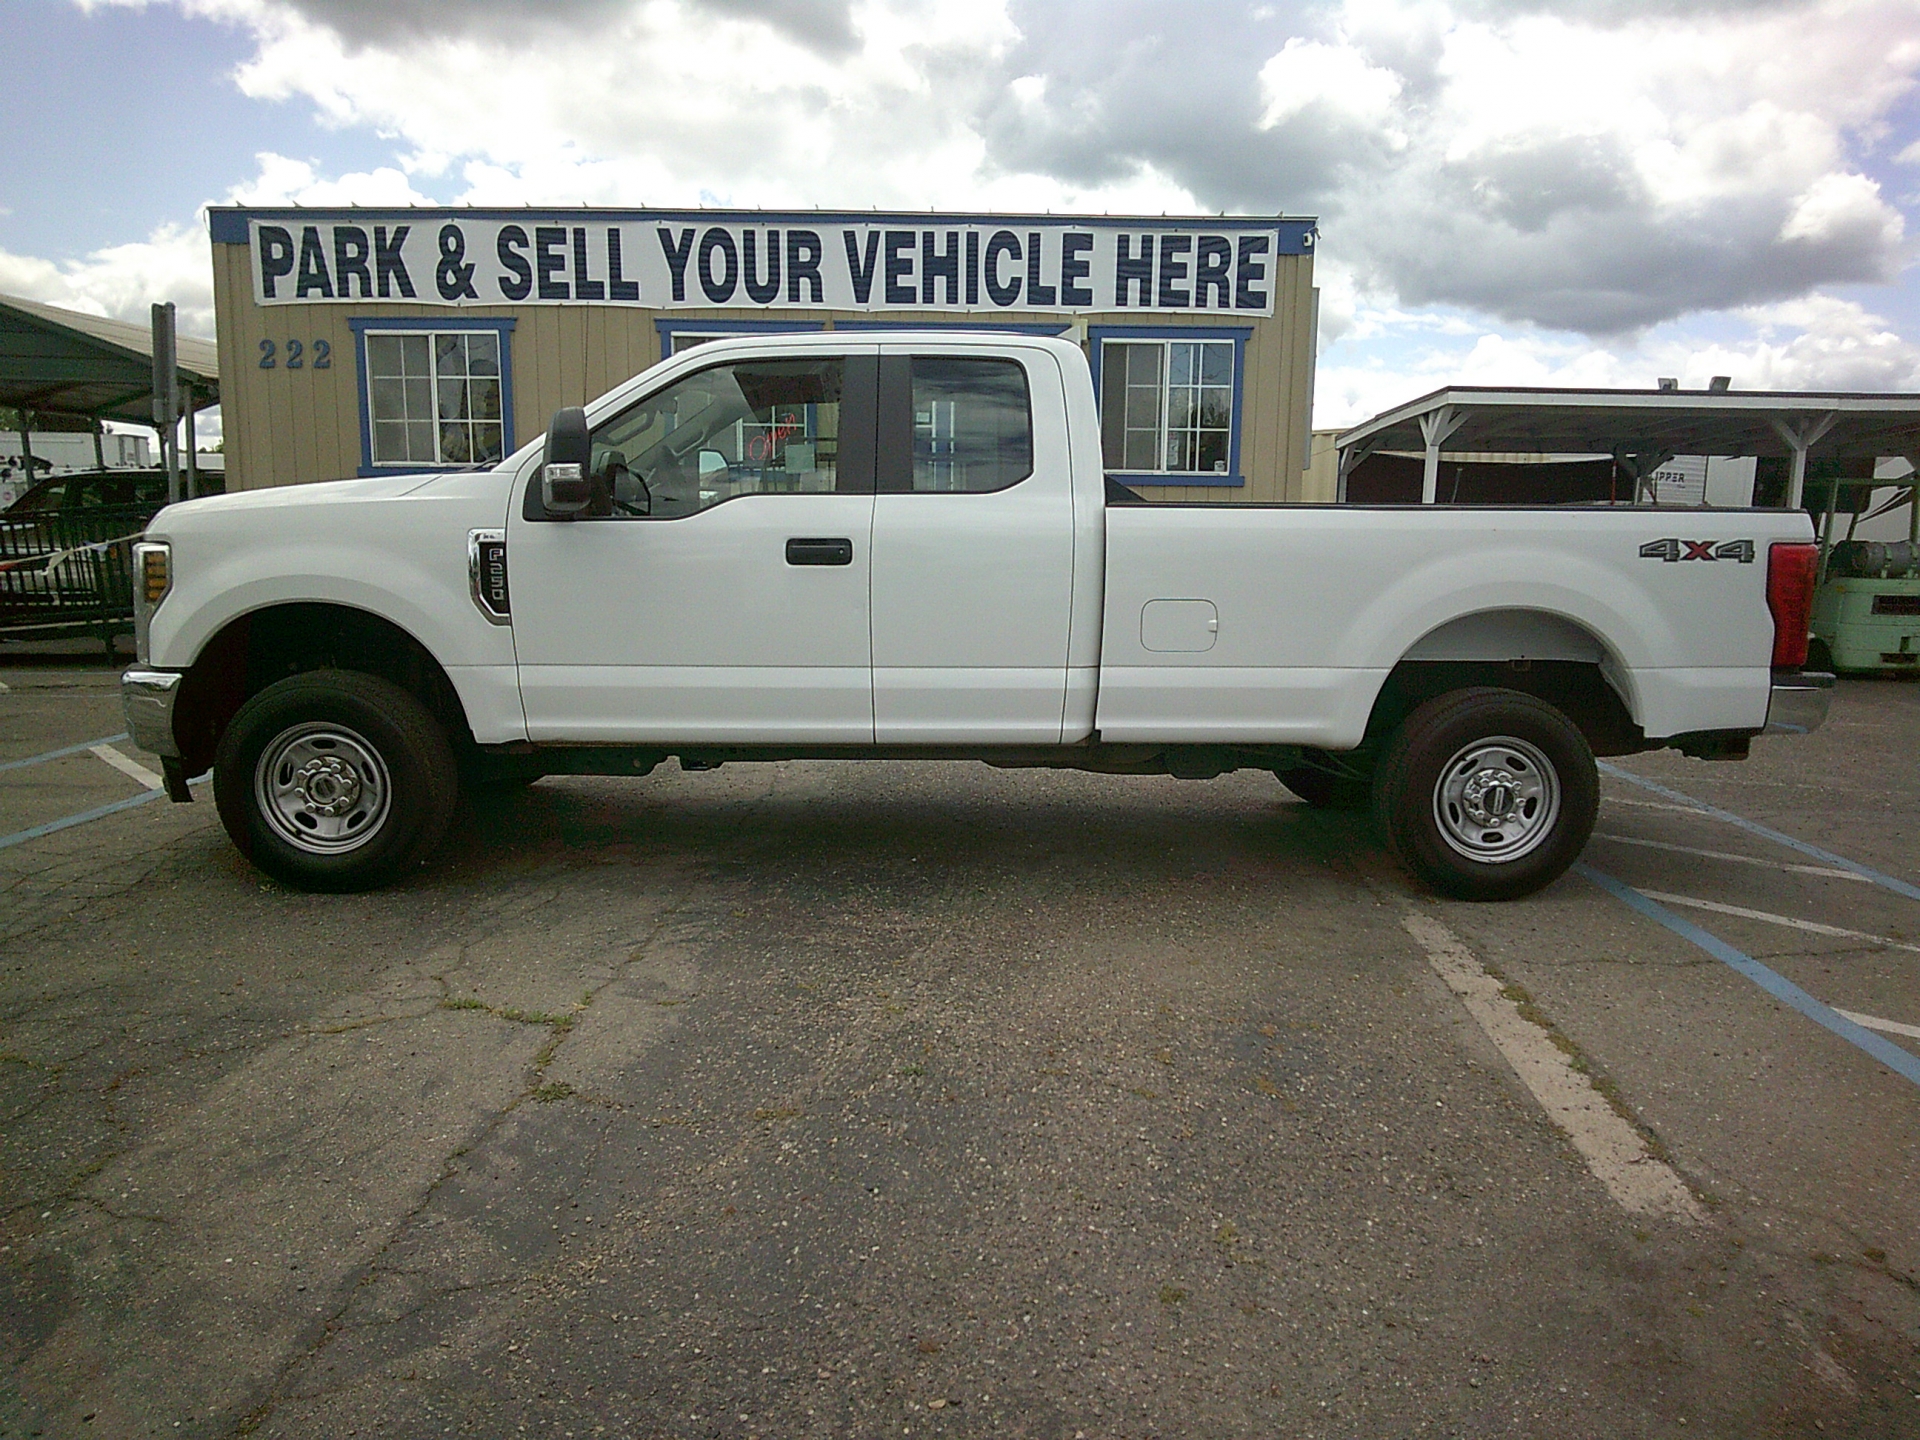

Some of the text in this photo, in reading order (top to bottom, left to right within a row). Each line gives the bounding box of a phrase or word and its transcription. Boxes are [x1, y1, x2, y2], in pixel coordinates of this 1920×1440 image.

[258, 223, 1270, 309] PARK & SELL YOUR VEHICLE HERE
[258, 338, 331, 369] 222
